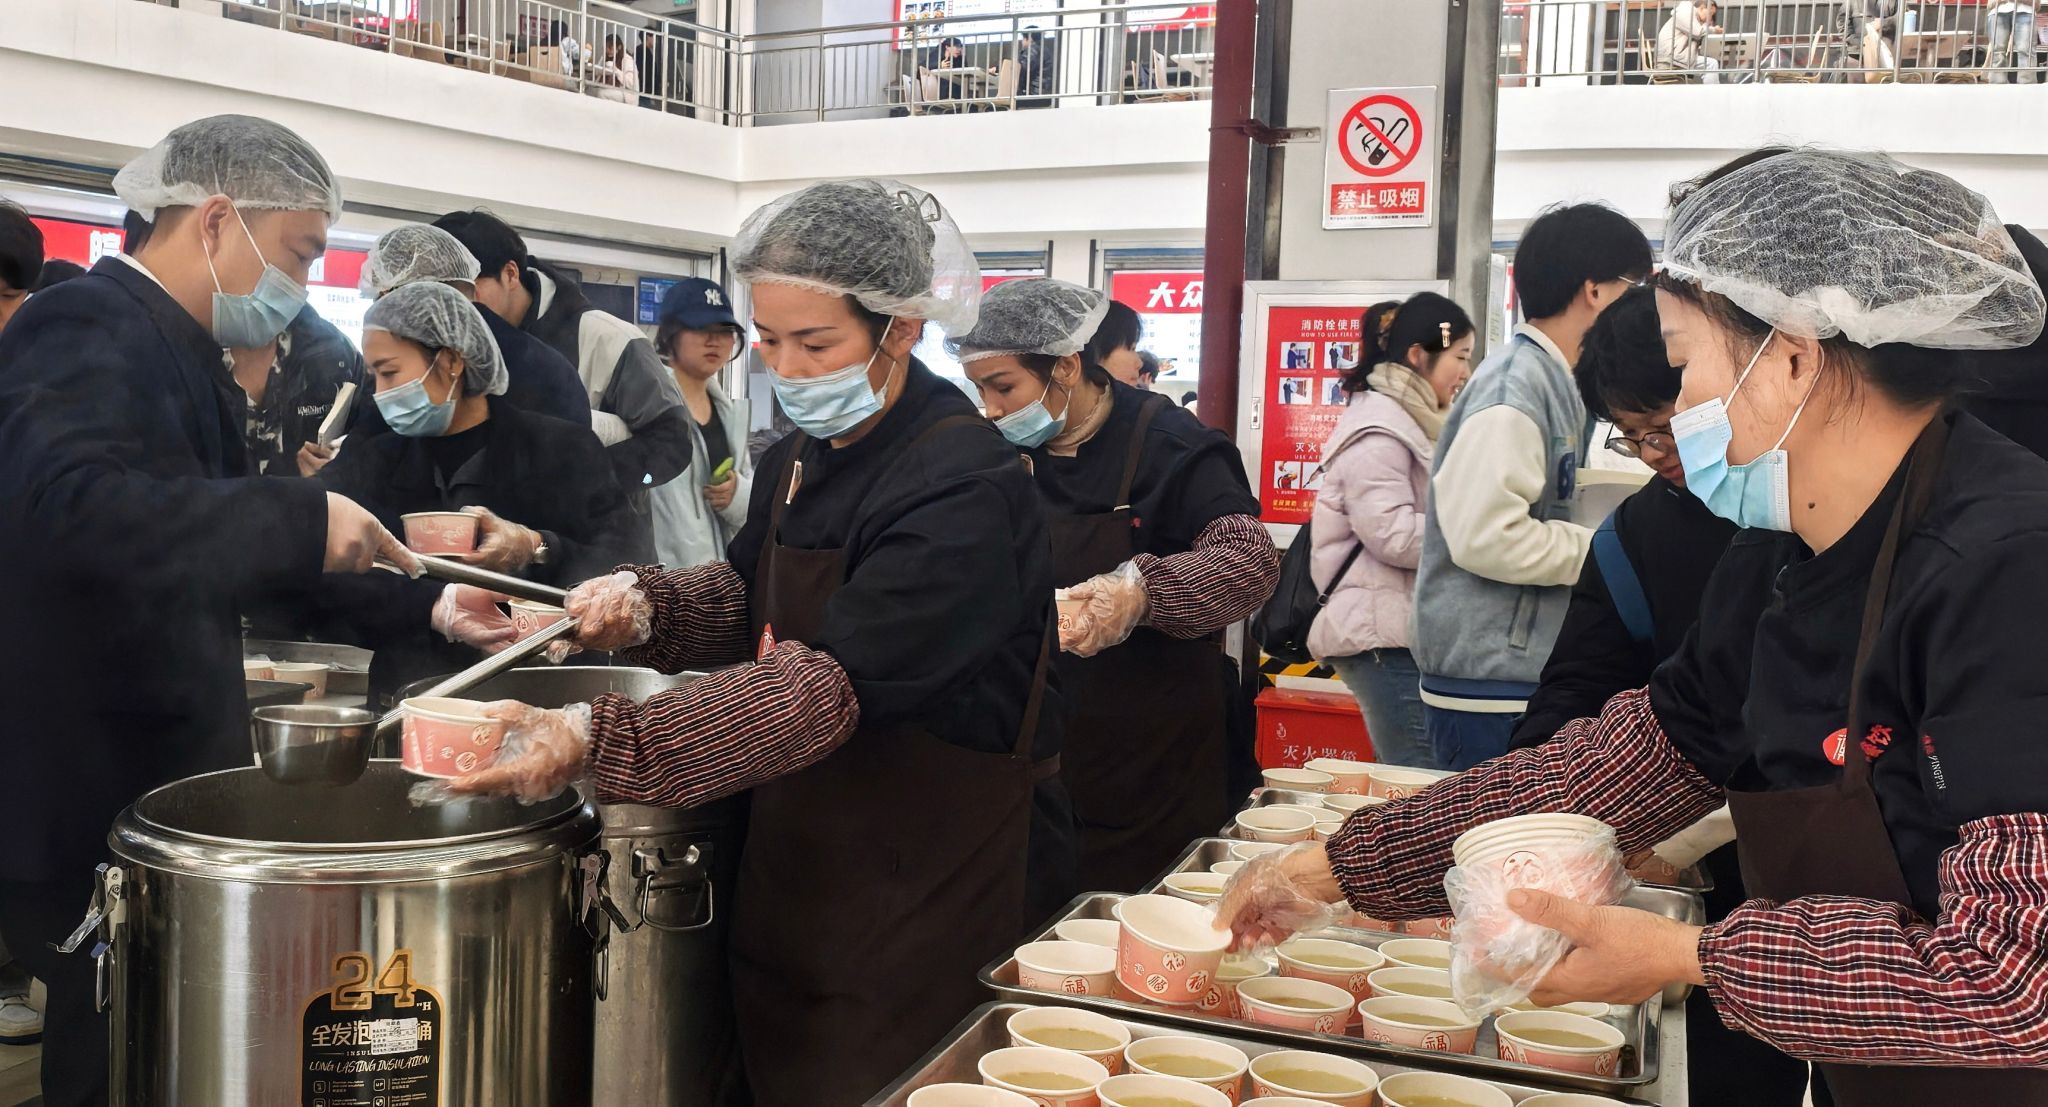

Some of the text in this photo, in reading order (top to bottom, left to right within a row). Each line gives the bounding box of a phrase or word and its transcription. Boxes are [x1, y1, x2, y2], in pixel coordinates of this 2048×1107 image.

[1337, 188, 1420, 209] 禁止吸烟
[704, 288, 724, 306] NY
[1301, 319, 1360, 331] 消防栓使用
[1928, 755, 1947, 790] YINGPIN
[331, 949, 416, 1010] 24
[1065, 978, 1086, 996] 福
[311, 1019, 432, 1047] 全发泡桶
[1426, 1035, 1447, 1052] 福
[309, 1055, 431, 1074] LONG LASTING INSULATION
